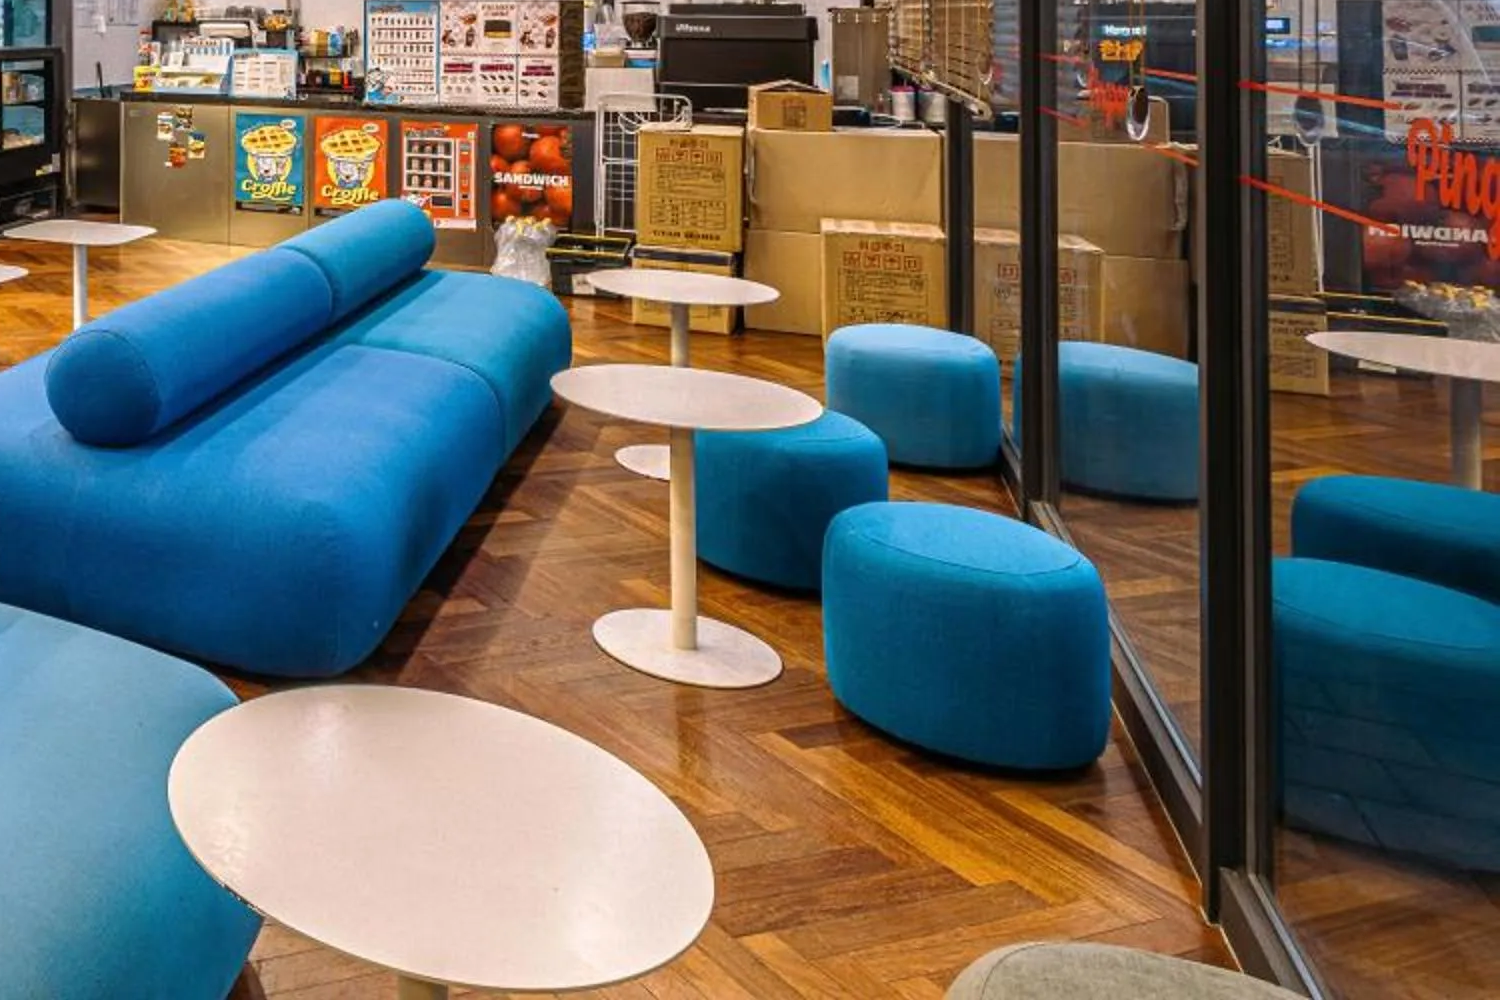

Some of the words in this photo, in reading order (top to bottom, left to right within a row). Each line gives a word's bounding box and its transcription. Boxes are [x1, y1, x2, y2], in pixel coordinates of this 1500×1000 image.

[242, 178, 297, 200] Croffle
[493, 171, 570, 187] SANDWICH
[321, 184, 379, 206] Croffle
